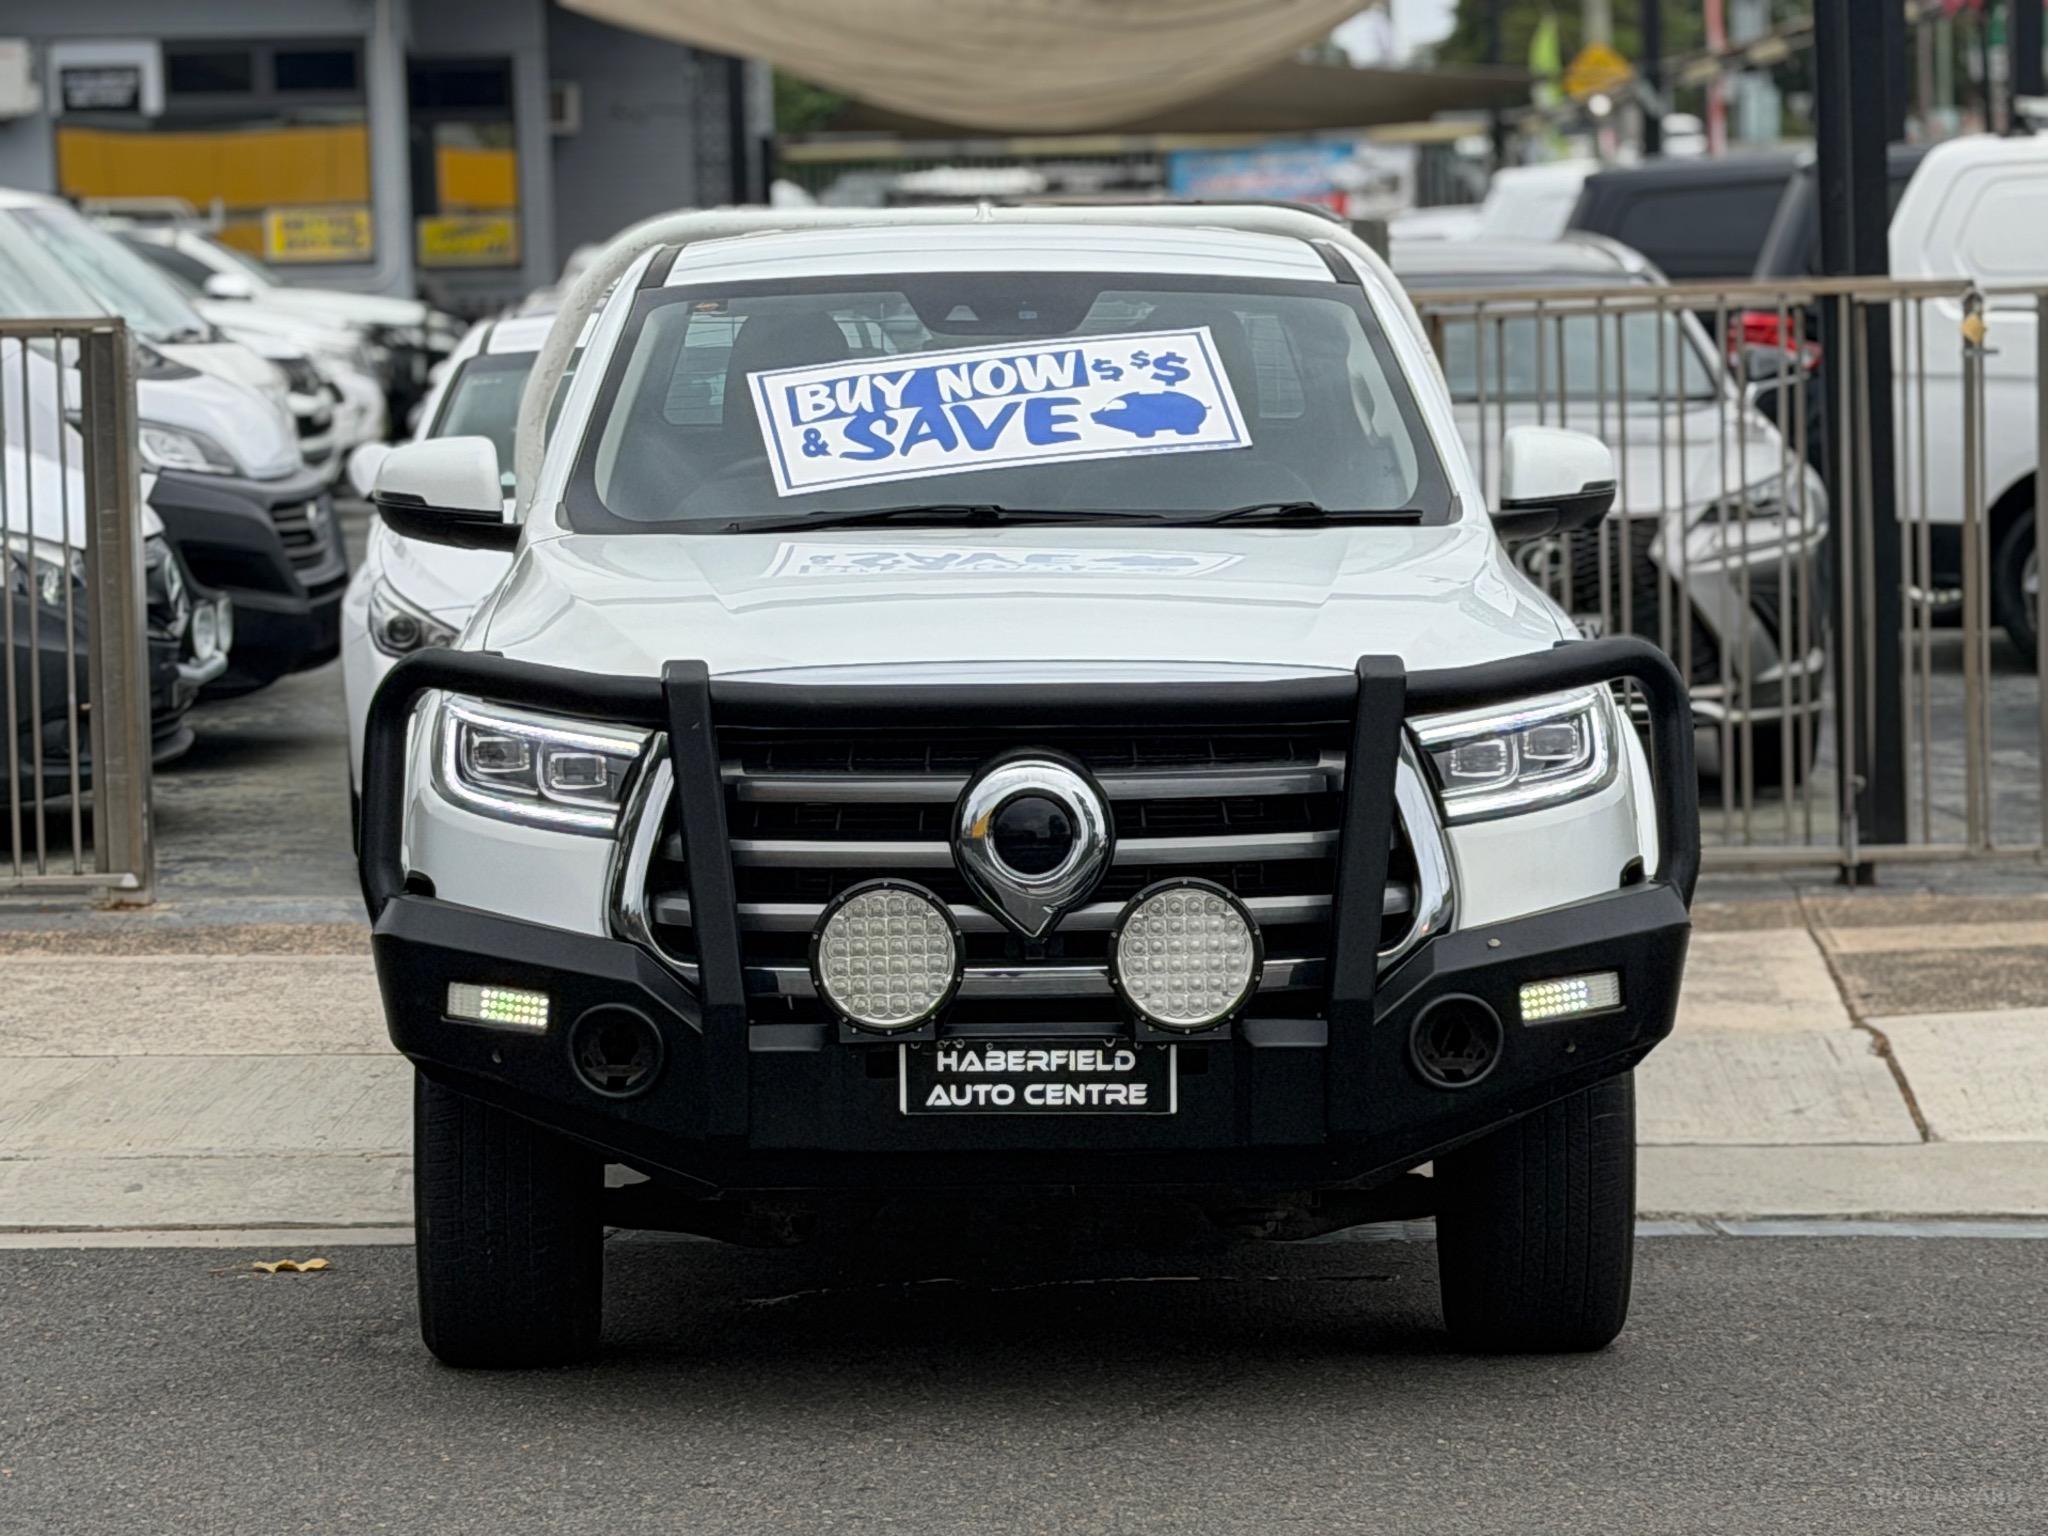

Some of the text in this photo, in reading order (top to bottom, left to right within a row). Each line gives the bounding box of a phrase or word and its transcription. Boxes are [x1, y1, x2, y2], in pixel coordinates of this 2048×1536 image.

[796, 371, 918, 422] BUY
[936, 350, 1079, 402] NOW
[802, 397, 1081, 460] & SAVE
[936, 1049, 1136, 1072] HABERFIELD
[925, 1083, 1149, 1106] AUTO CENTRE
